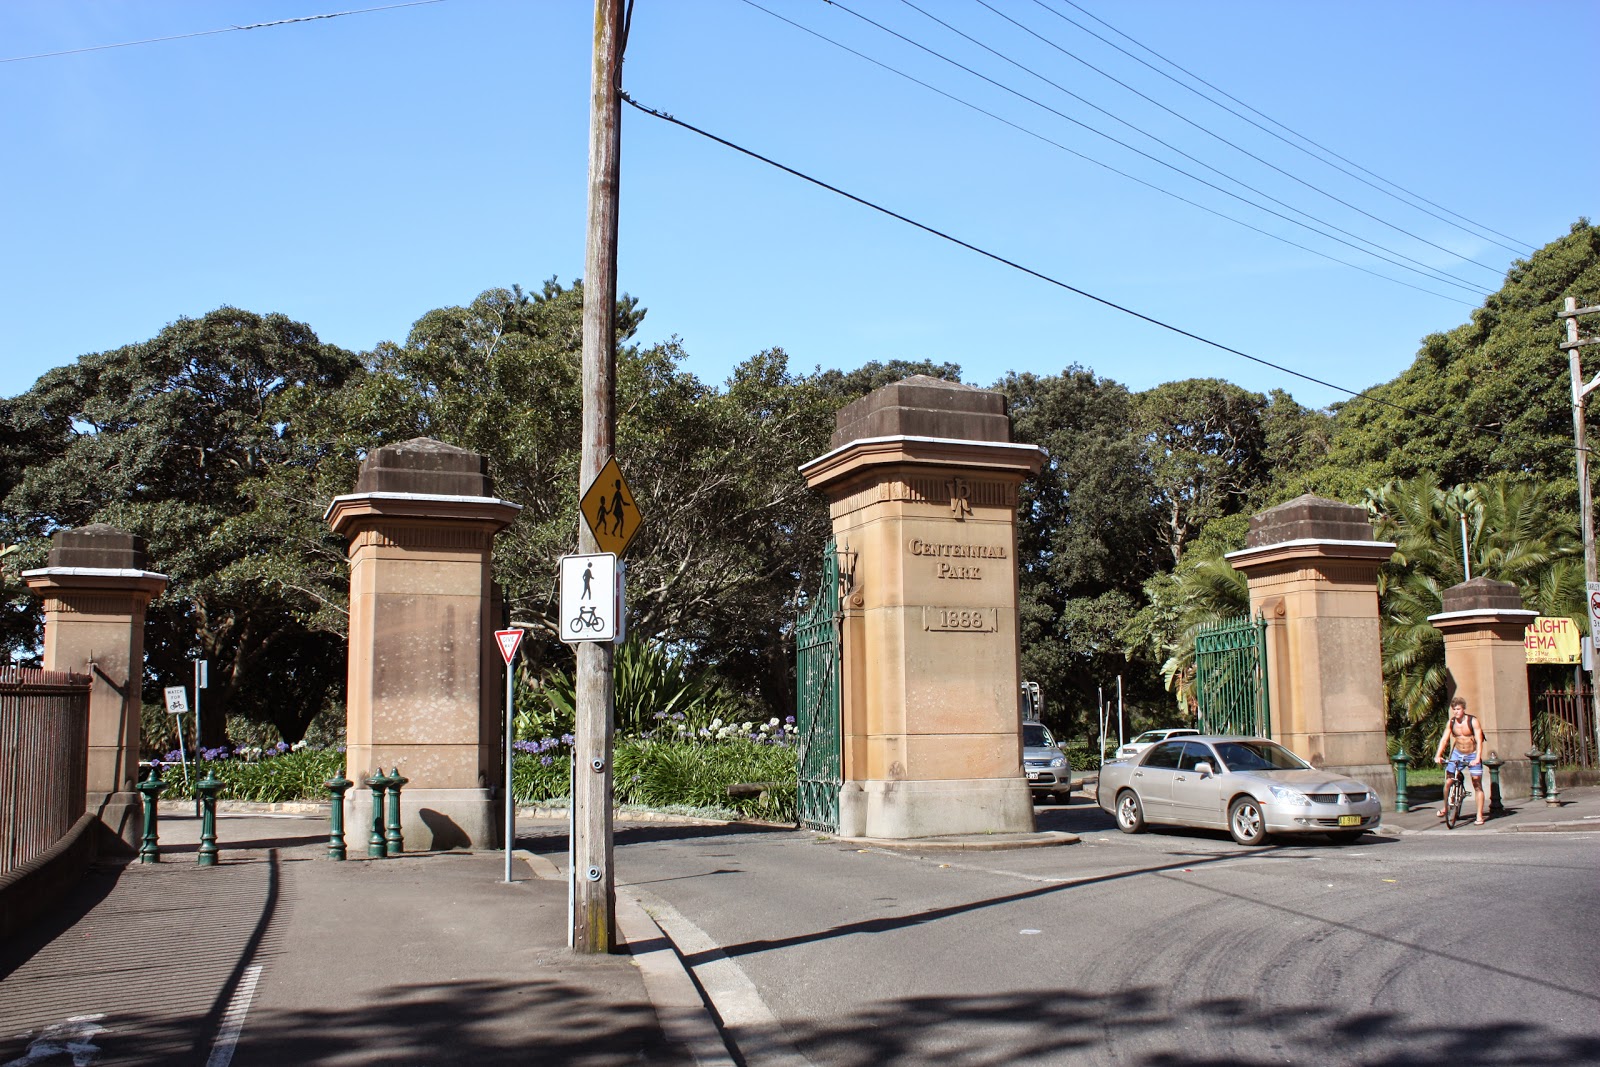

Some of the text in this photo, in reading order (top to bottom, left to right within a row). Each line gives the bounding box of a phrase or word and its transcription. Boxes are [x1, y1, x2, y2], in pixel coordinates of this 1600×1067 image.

[909, 538, 1007, 559] CENTENNIAL
[937, 561, 982, 580] PARK
[940, 610, 983, 628] 1888
